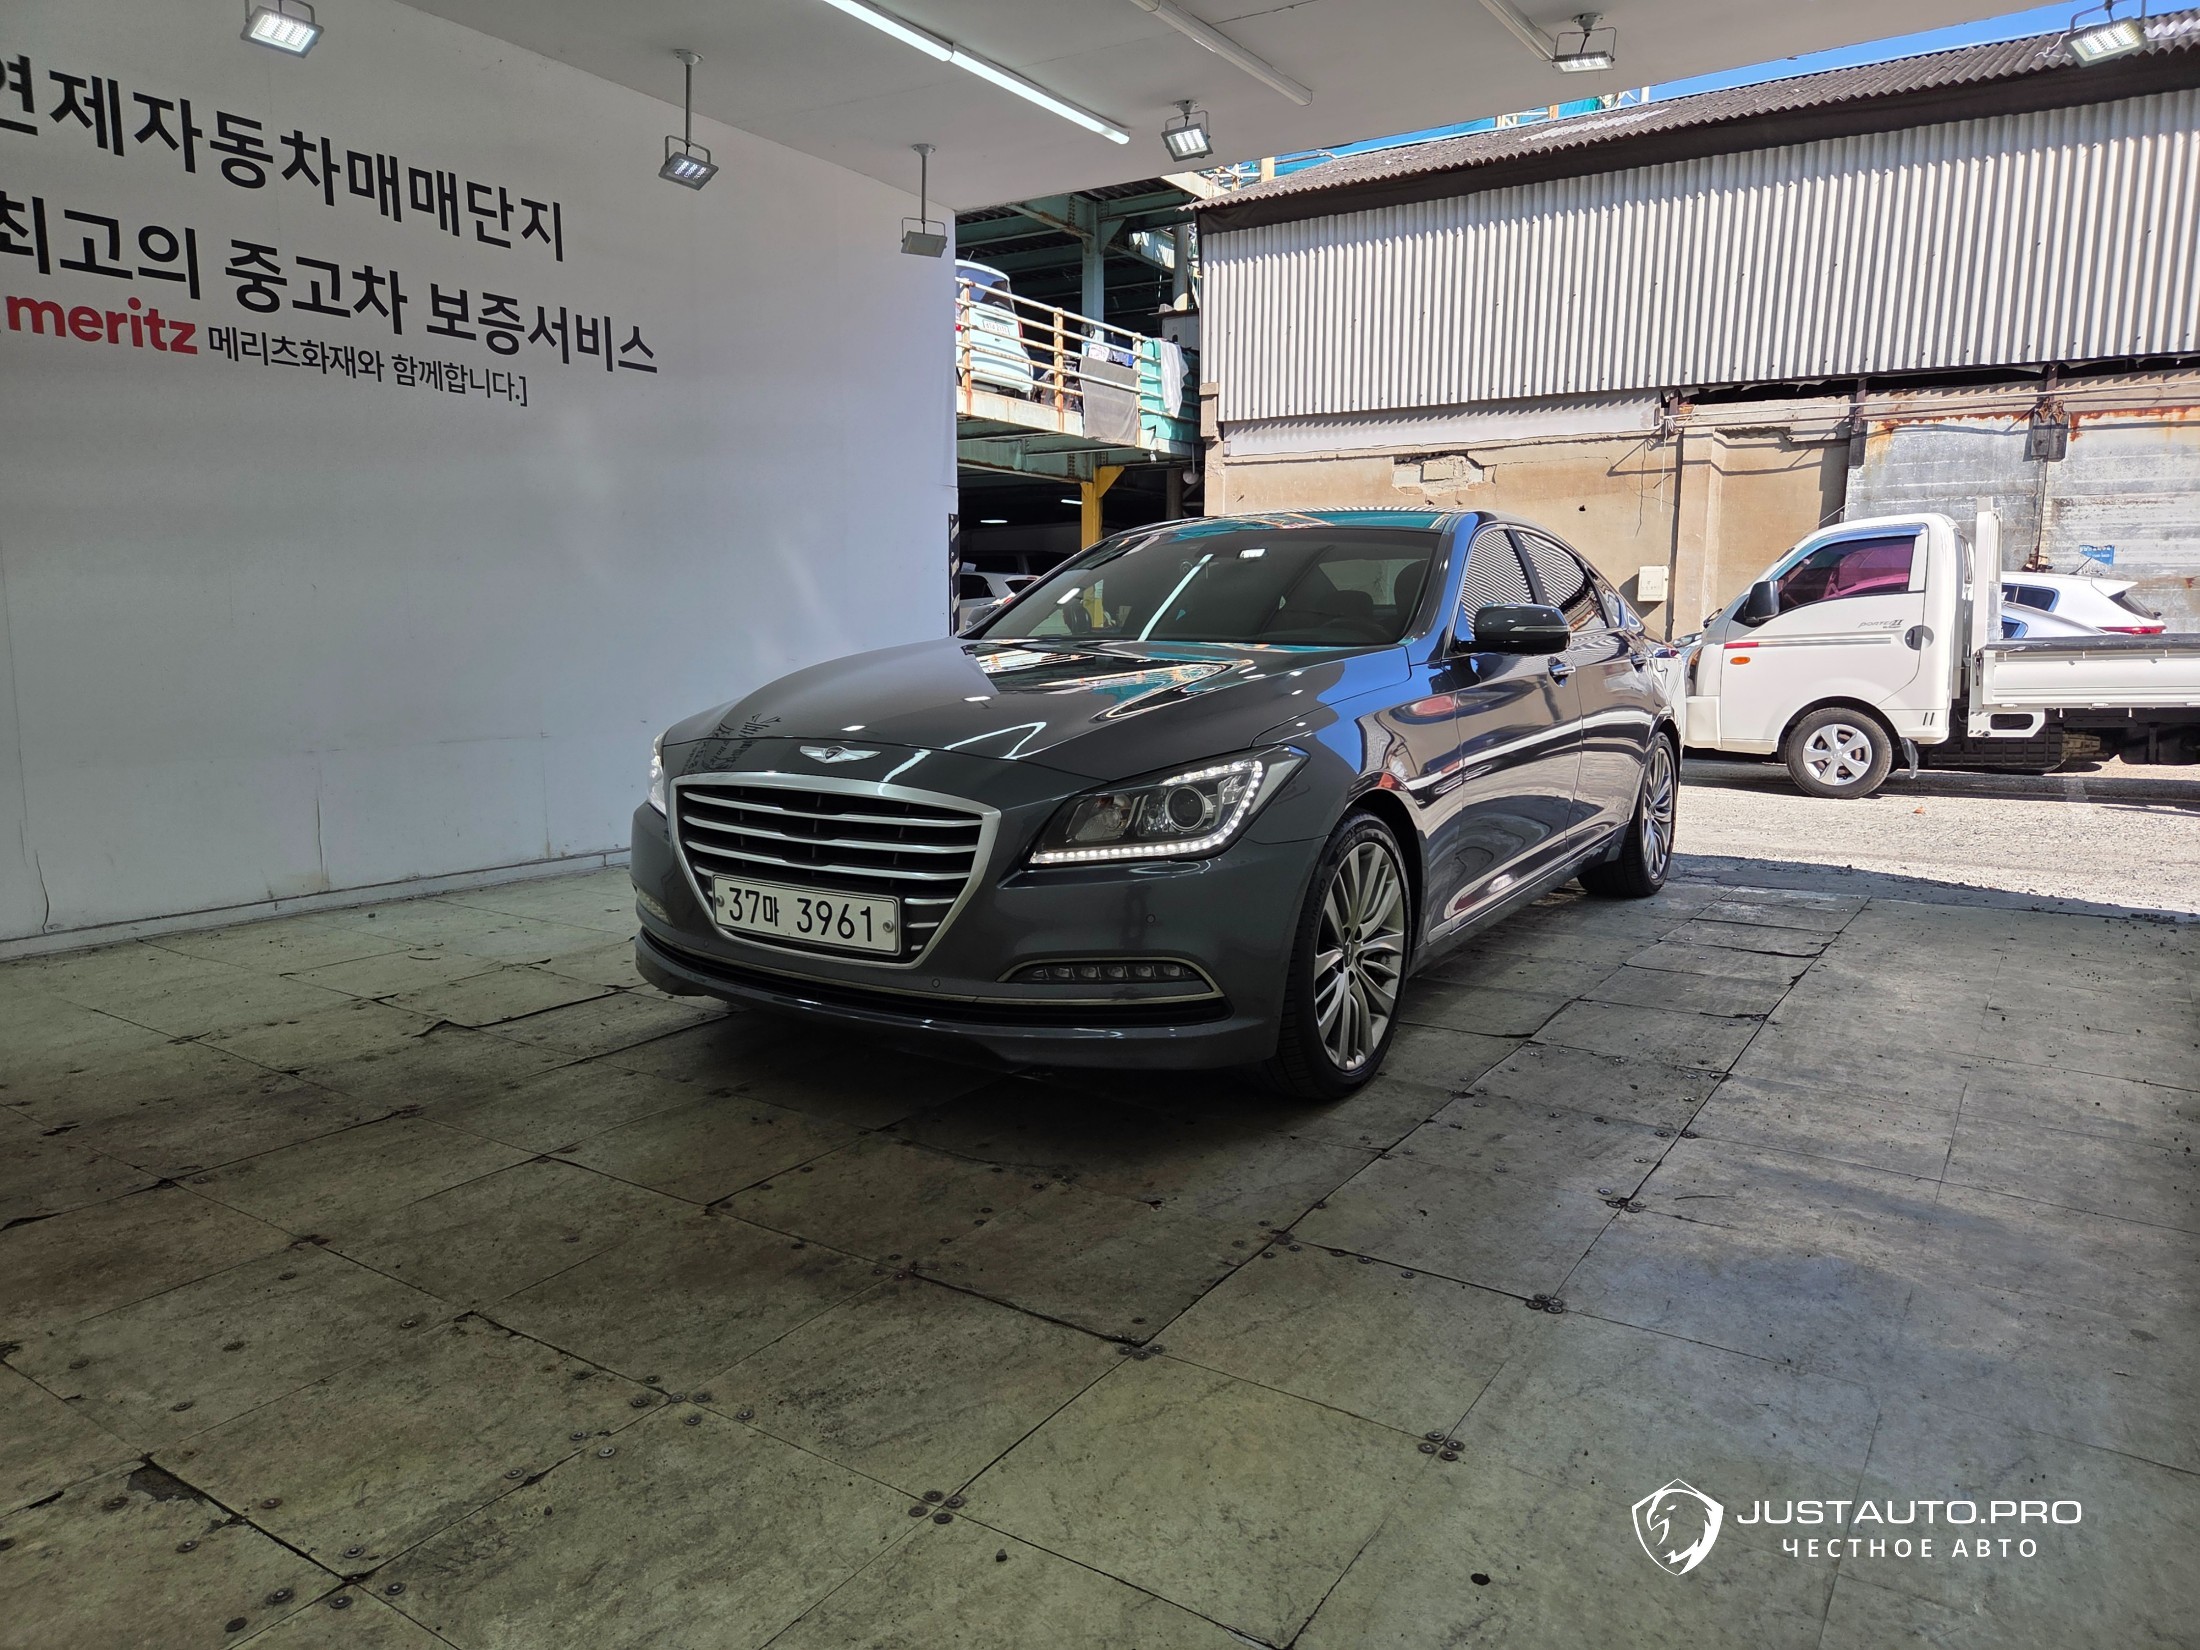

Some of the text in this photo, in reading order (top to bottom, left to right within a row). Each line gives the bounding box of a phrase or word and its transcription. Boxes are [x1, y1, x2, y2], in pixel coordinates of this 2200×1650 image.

[0, 190, 658, 374] 최고의 중고차 보증서비스
[5, 295, 528, 408] meritz 메리츠화재와 함께합니다.]
[729, 887, 872, 942] 37마 3961
